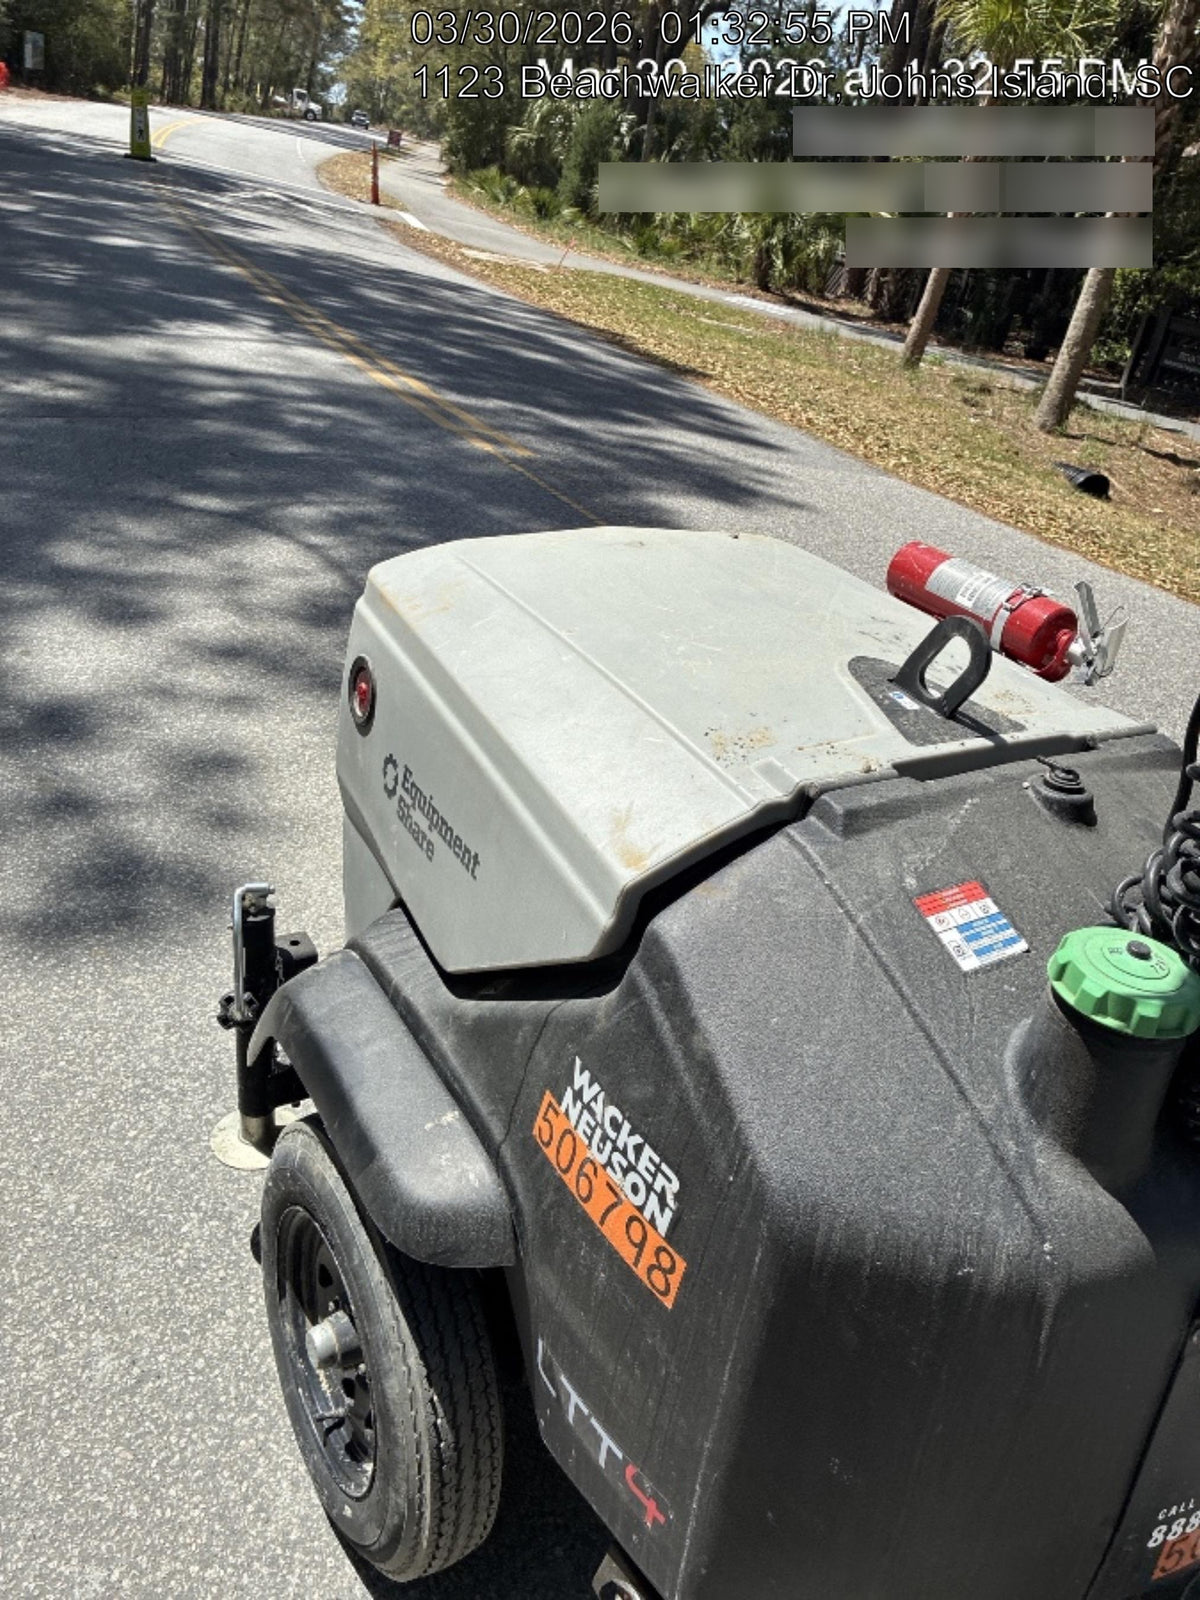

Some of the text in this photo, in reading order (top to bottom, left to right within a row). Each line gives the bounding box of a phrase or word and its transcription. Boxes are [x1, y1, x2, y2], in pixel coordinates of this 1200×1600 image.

[396, 794, 435, 863] Share
[400, 763, 481, 881] Equipment
[538, 1101, 676, 1298] 506798
[560, 1085, 676, 1238] NEUSON
[573, 1055, 681, 1209] WACKER
[1157, 1498, 1195, 1520] CALL
